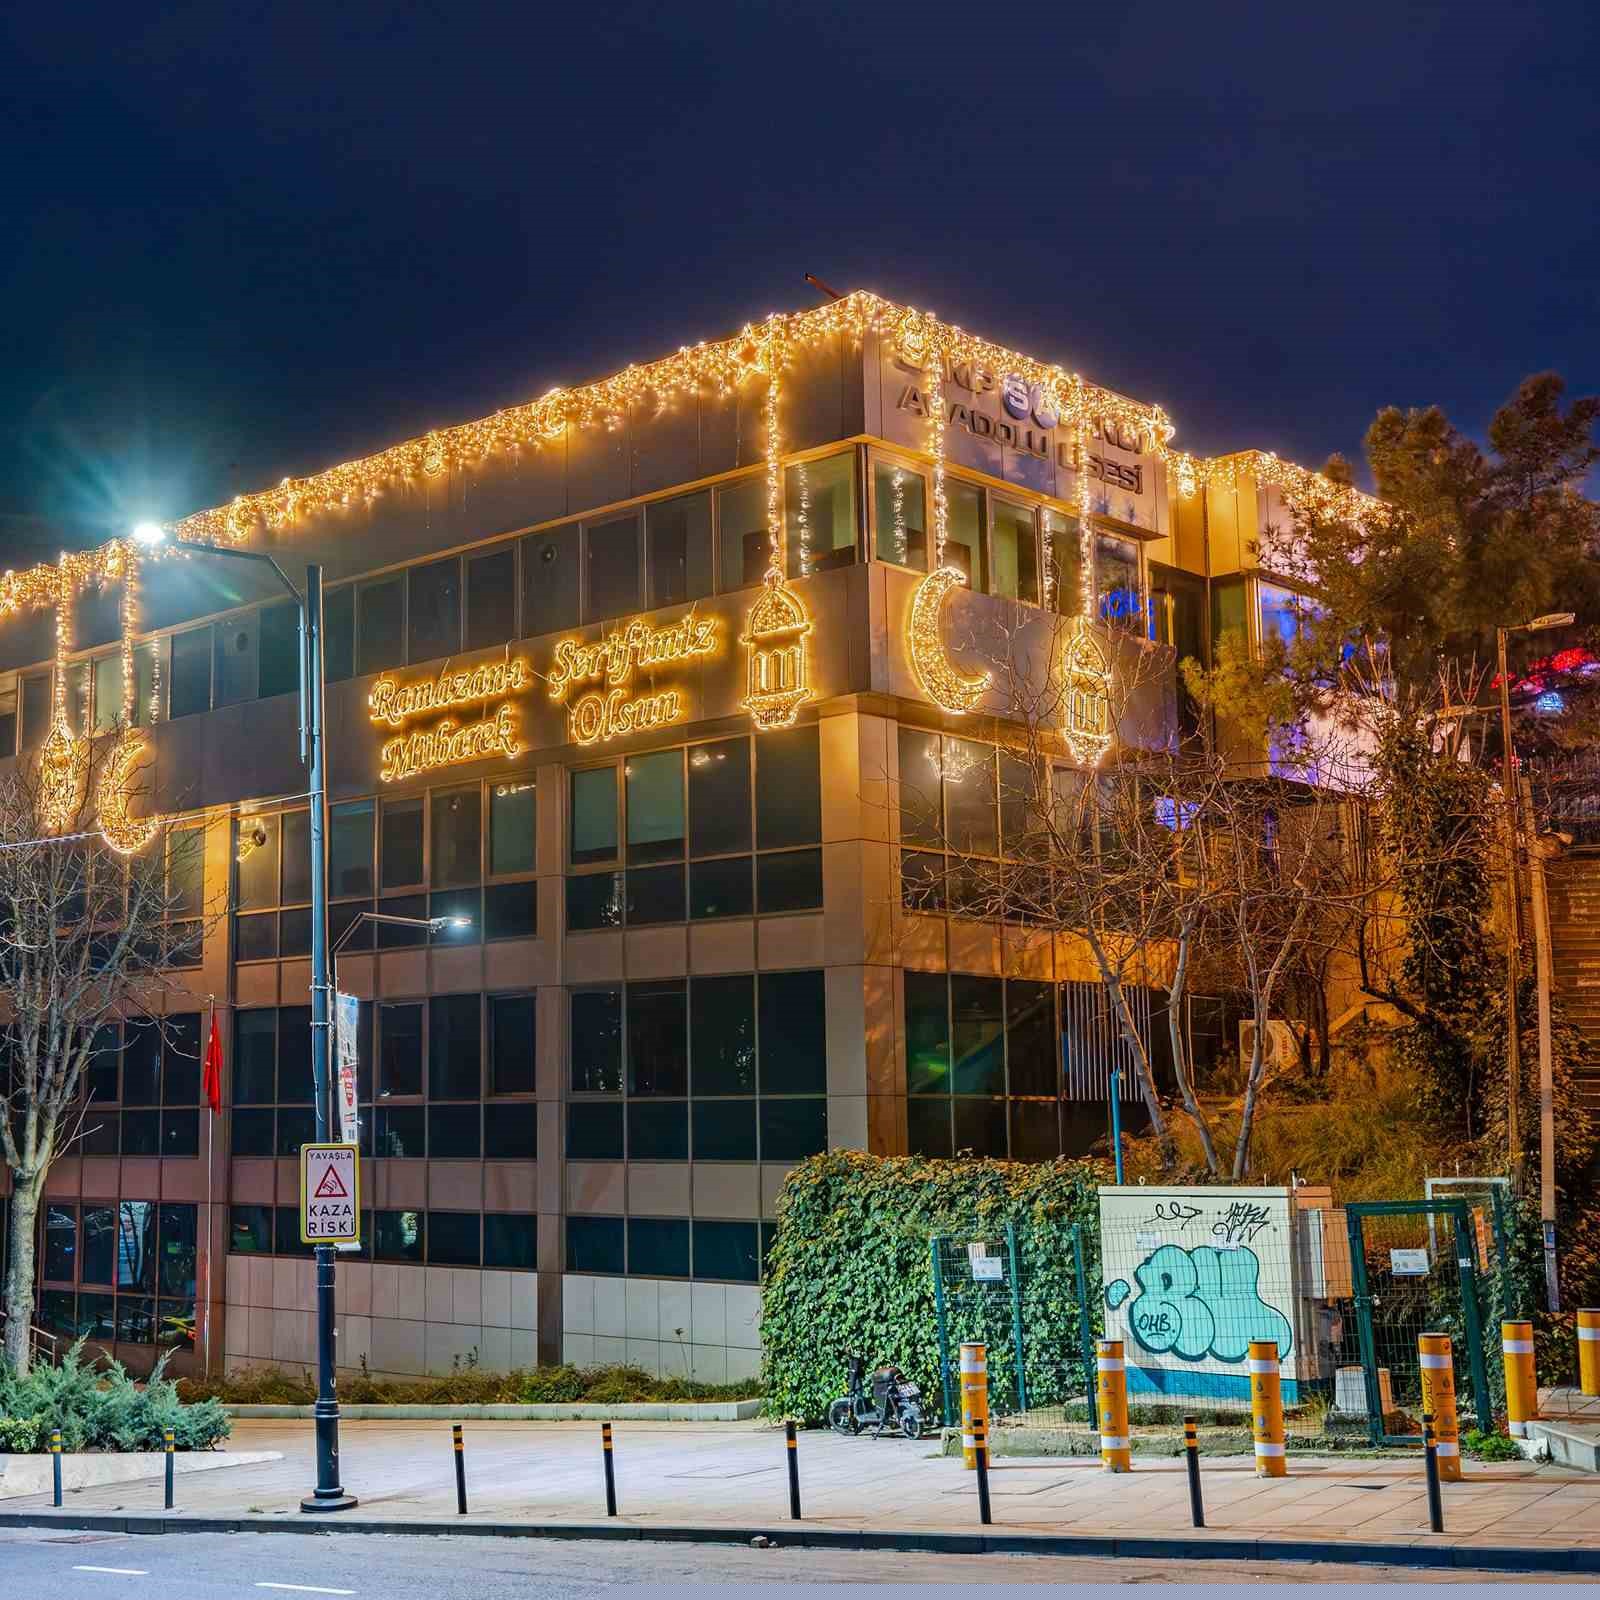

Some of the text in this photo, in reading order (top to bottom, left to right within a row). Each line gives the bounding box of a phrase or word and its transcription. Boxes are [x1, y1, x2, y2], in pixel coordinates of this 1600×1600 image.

[897, 382, 1048, 459] AADOLU
[549, 615, 718, 699] Şerifimiz
[380, 688, 681, 782] Mübarek Olsun
[309, 1151, 353, 1161] YAVAŞLA
[308, 1217, 354, 1234] RİSKİ
[309, 1203, 353, 1217] KAZA
